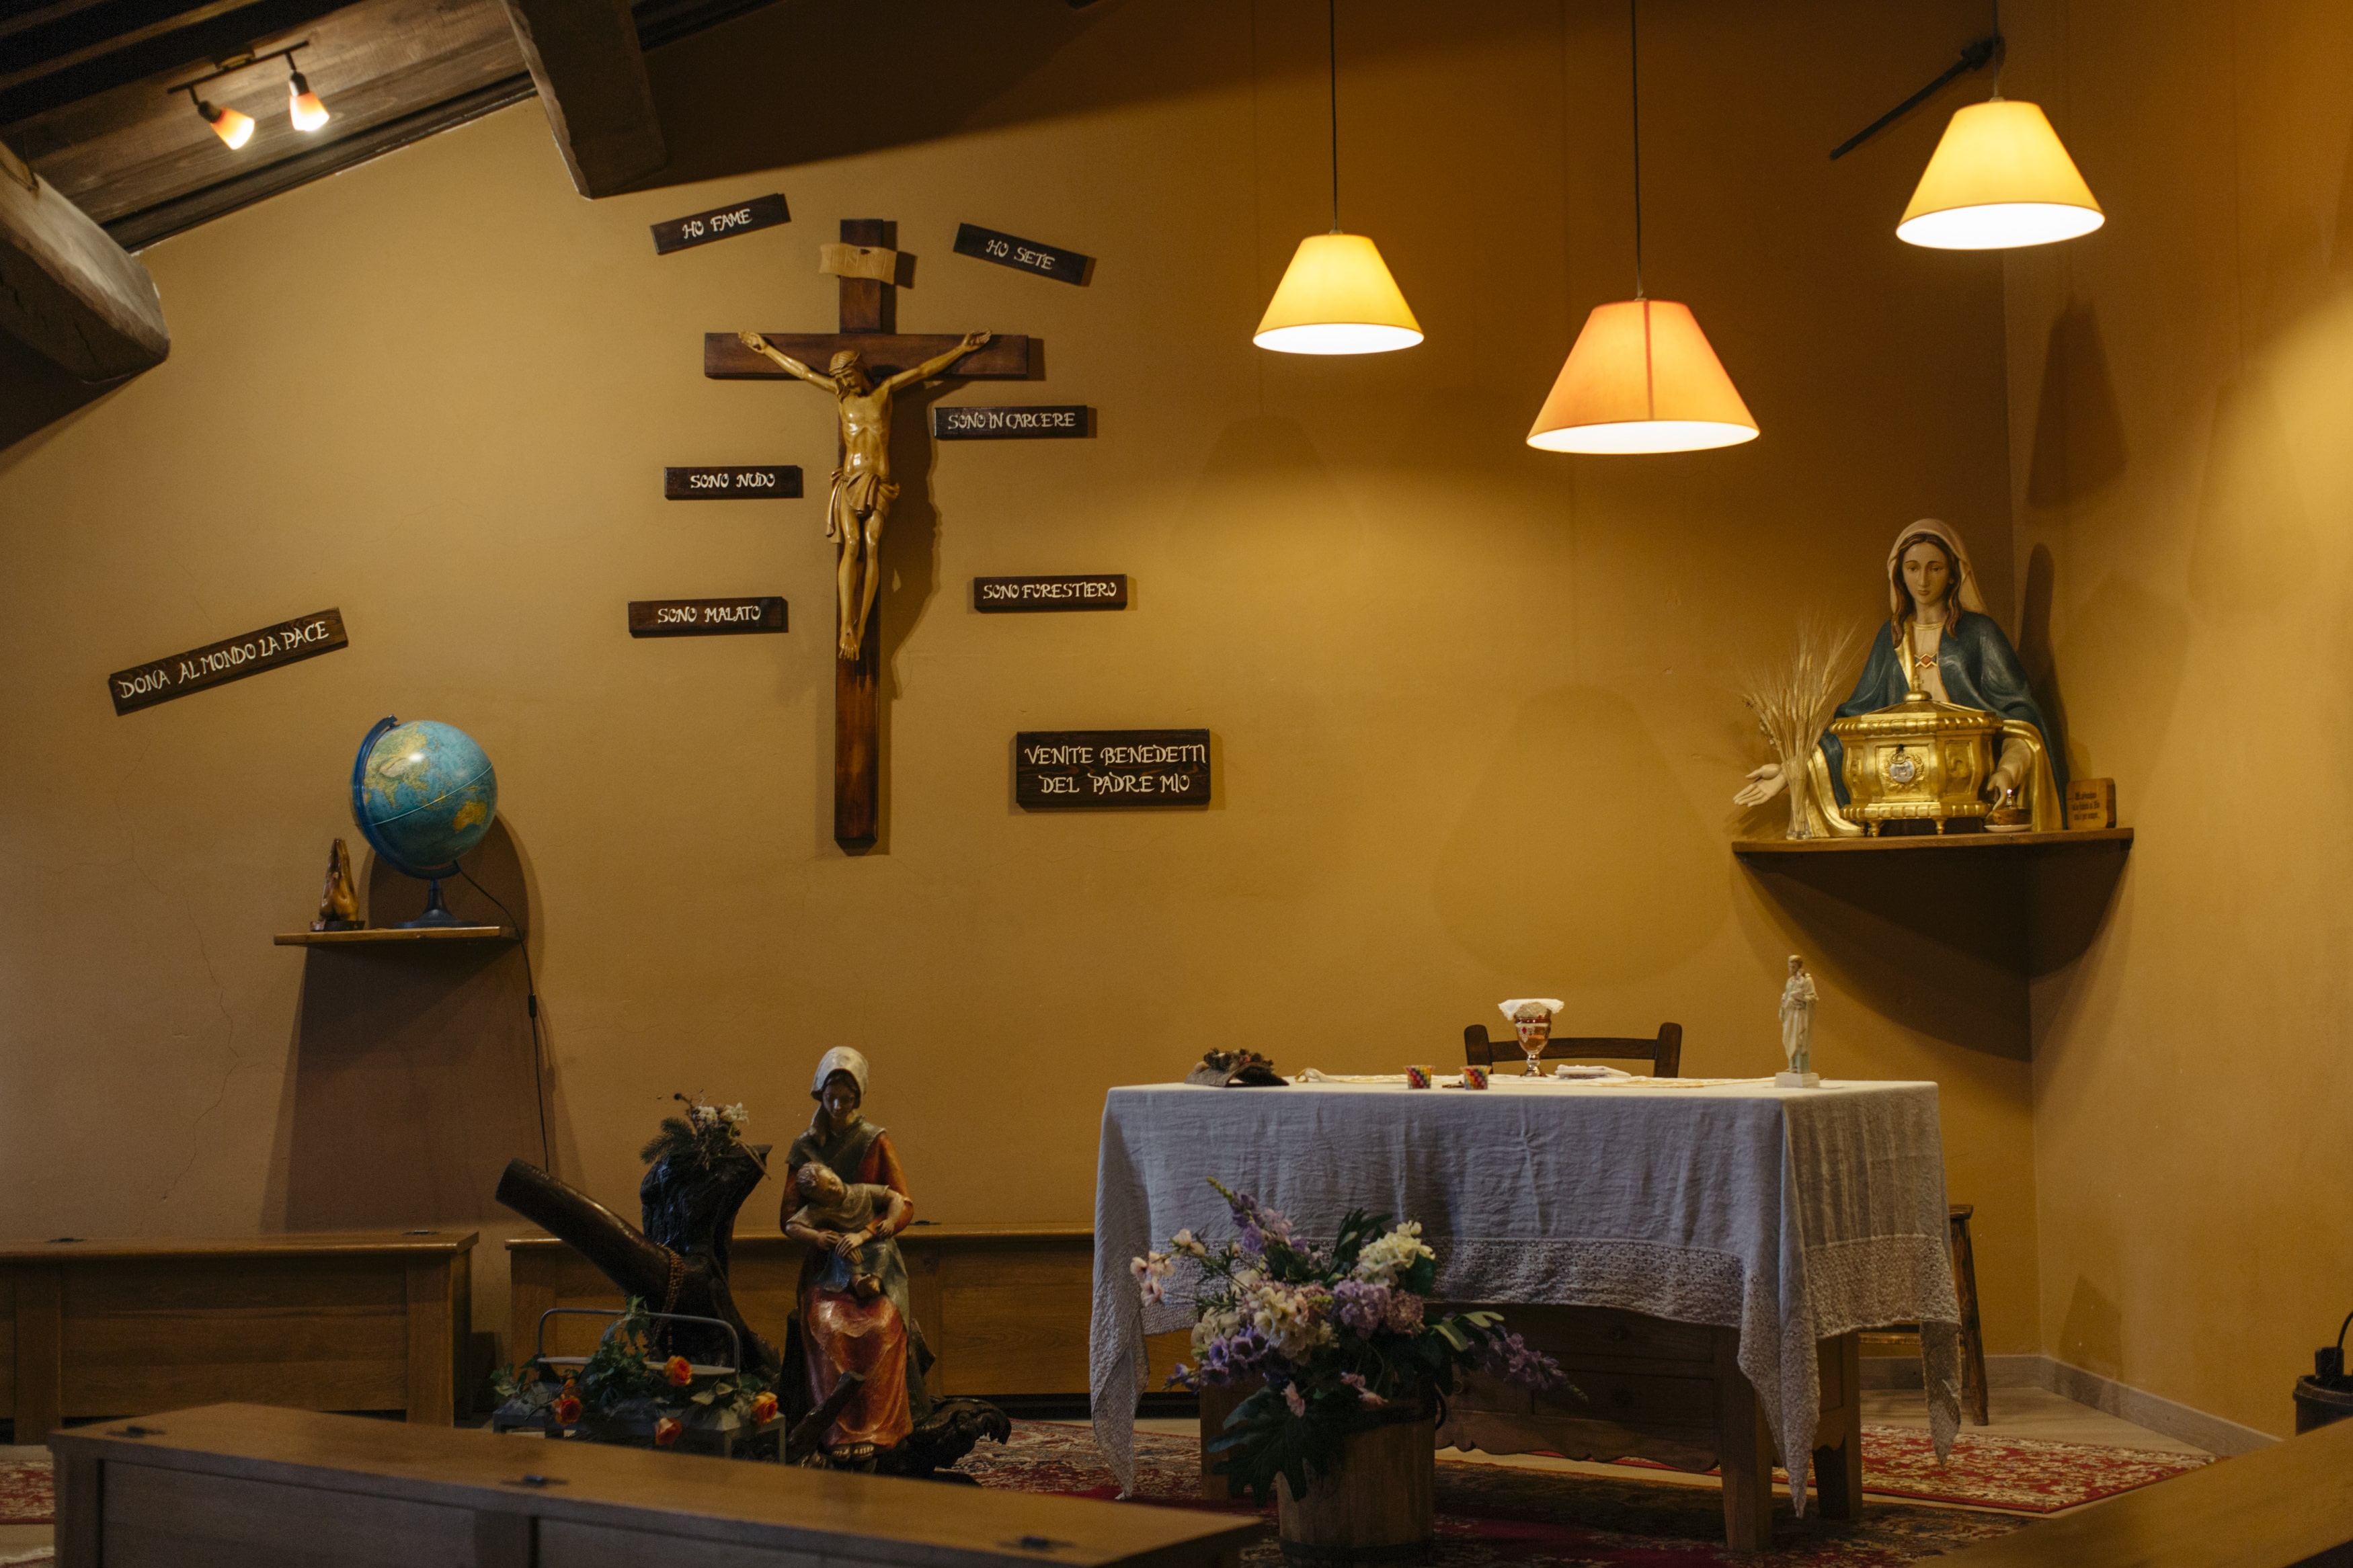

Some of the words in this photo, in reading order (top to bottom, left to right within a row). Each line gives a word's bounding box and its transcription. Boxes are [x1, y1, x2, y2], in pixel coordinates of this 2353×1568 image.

[682, 221, 704, 239] HO
[710, 208, 752, 232] FAME
[830, 245, 887, 277] INRI
[986, 239, 1009, 257] HO
[1014, 247, 1055, 270] SETE
[948, 413, 986, 430] SONO
[989, 412, 1003, 429] IN
[1006, 413, 1076, 429] CARCERE
[690, 473, 729, 489] SONO
[736, 472, 775, 488] NUDO
[983, 583, 1019, 600] SONO
[1022, 581, 1117, 599] FORESTIERO
[657, 606, 697, 624] SONO
[705, 605, 761, 623] MALATO
[118, 669, 171, 699] DONA
[178, 661, 200, 684] AL
[200, 643, 257, 674] MONDO
[258, 636, 281, 657] LA
[280, 621, 329, 650] PACE
[1025, 745, 1094, 765] VENITE
[1100, 744, 1205, 766] BENEDETTI
[1038, 774, 1080, 793] DEL
[1087, 772, 1155, 795] PADRE
[1160, 774, 1190, 793] MIO
